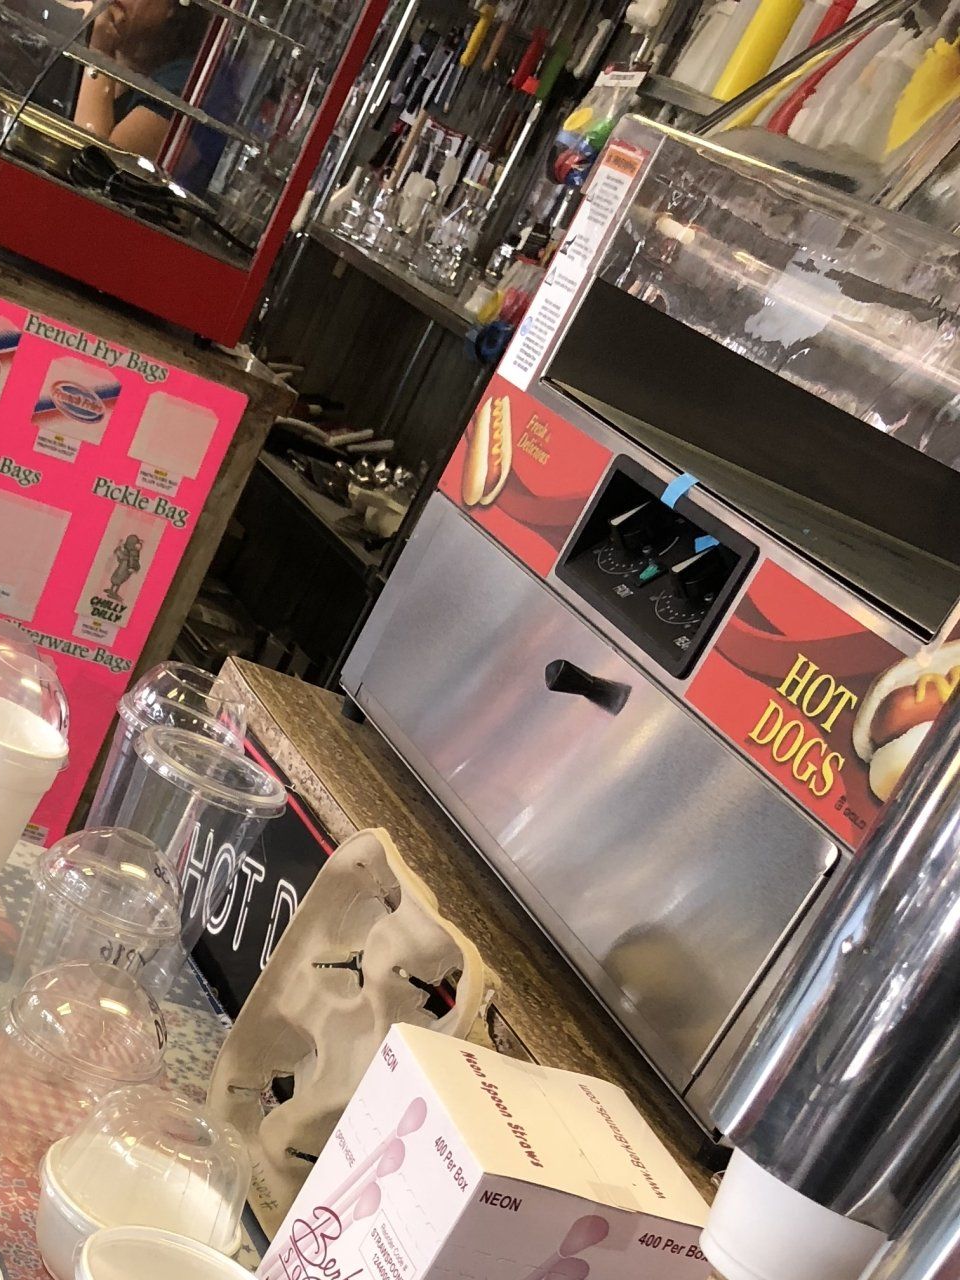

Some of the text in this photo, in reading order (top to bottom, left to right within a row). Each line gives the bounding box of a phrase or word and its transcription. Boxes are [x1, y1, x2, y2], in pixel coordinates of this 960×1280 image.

[25, 313, 169, 382] French Fry Bags
[0, 457, 42, 487] Bags
[93, 477, 149, 510] Pickle
[154, 498, 190, 528] Bag
[92, 647, 133, 673] Bags
[776, 652, 858, 733] HOT
[748, 699, 846, 797] DOGS
[181, 822, 266, 951] HOT
[381, 1043, 399, 1073] NEON
[460, 1050, 544, 1170] Neon Spoon Straws
[434, 1136, 469, 1193] 400 Per Box
[478, 1189, 523, 1212] NEON
[638, 1232, 662, 1250] 400
[663, 1239, 686, 1257] Per
